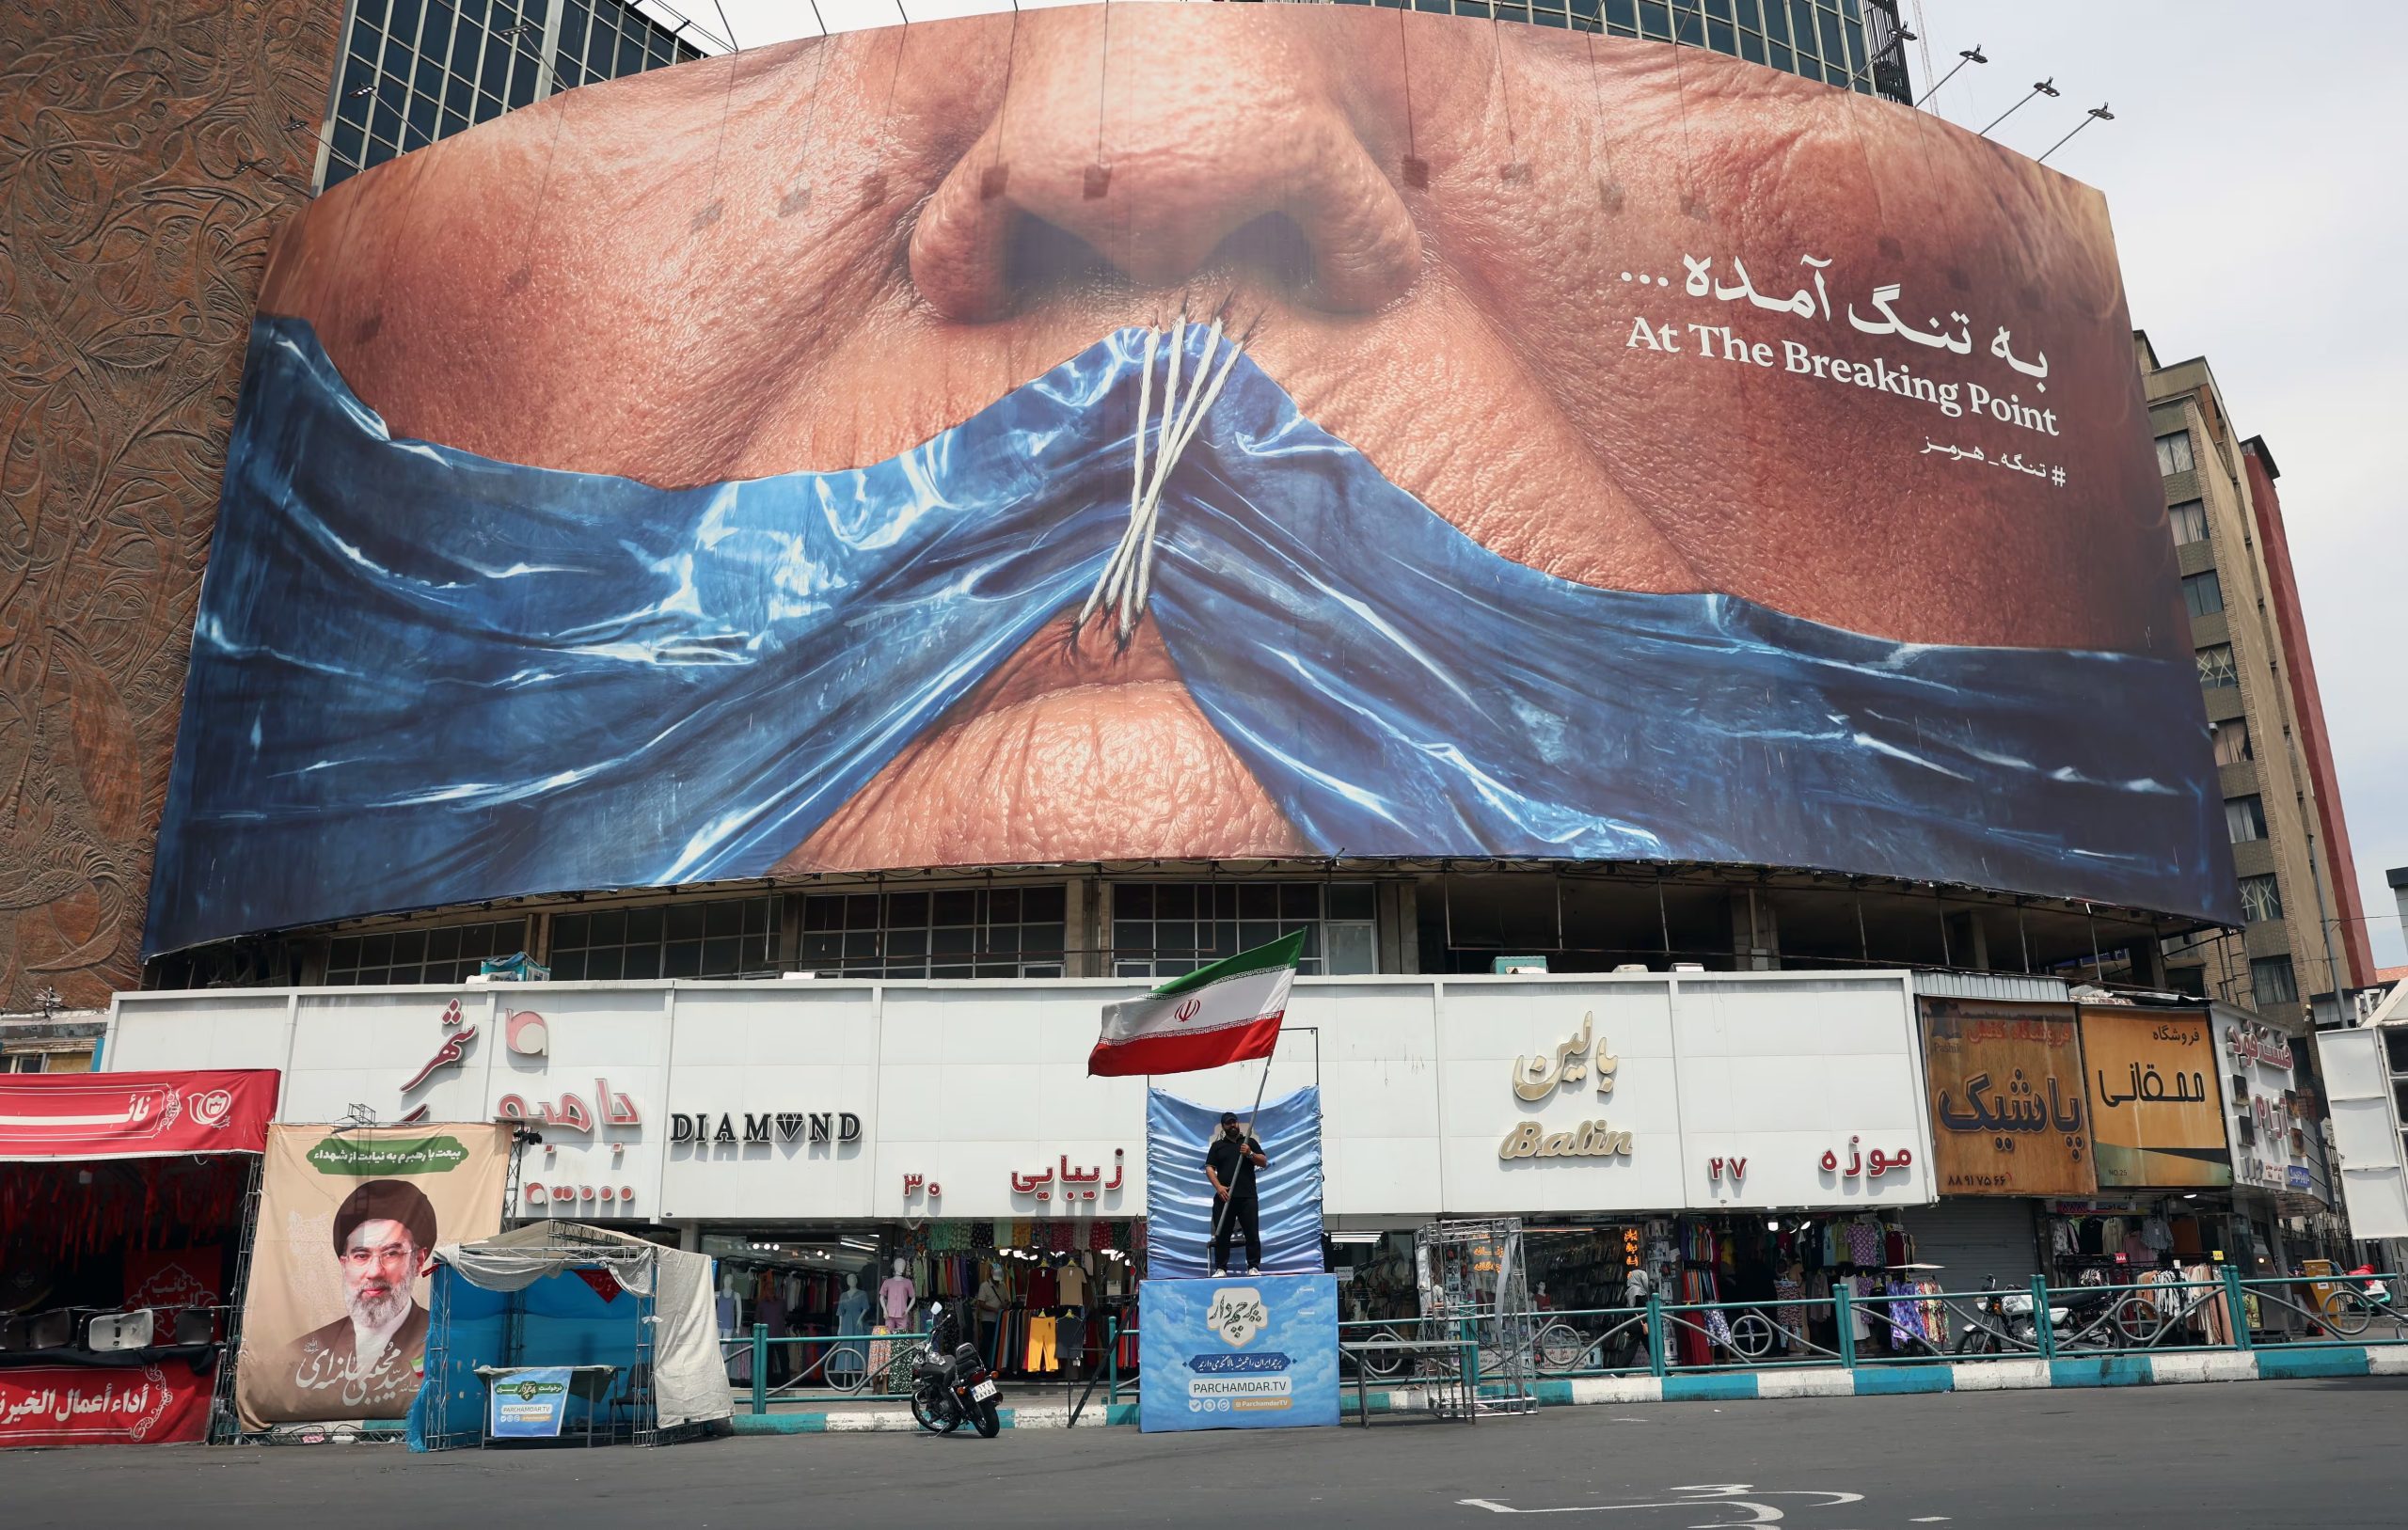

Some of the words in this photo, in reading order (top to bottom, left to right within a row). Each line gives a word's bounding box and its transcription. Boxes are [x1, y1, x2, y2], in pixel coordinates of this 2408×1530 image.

[1684, 253, 1832, 323] آمده
[1847, 283, 1972, 355] تنگ
[1625, 316, 1681, 354] At
[1687, 323, 1774, 368] The
[1782, 339, 1963, 418] Breaking
[1967, 381, 2060, 436] Point
[1989, 324, 2050, 393] به
[1513, 1010, 1619, 1102] بالین
[2152, 1024, 2200, 1047] فروشگاه
[1939, 1068, 2084, 1162] پاشیک
[386, 1152, 397, 1164] به
[436, 1148, 462, 1159] بیعت
[1498, 1119, 1634, 1160] Balin
[1818, 1135, 1913, 1178] موزه
[1010, 1147, 1125, 1202] زیبایی
[55, 1382, 113, 1422] أعمال
[111, 1382, 150, 1413] أداء
[1194, 1380, 1287, 1394] PARCHAMDAR.TV
